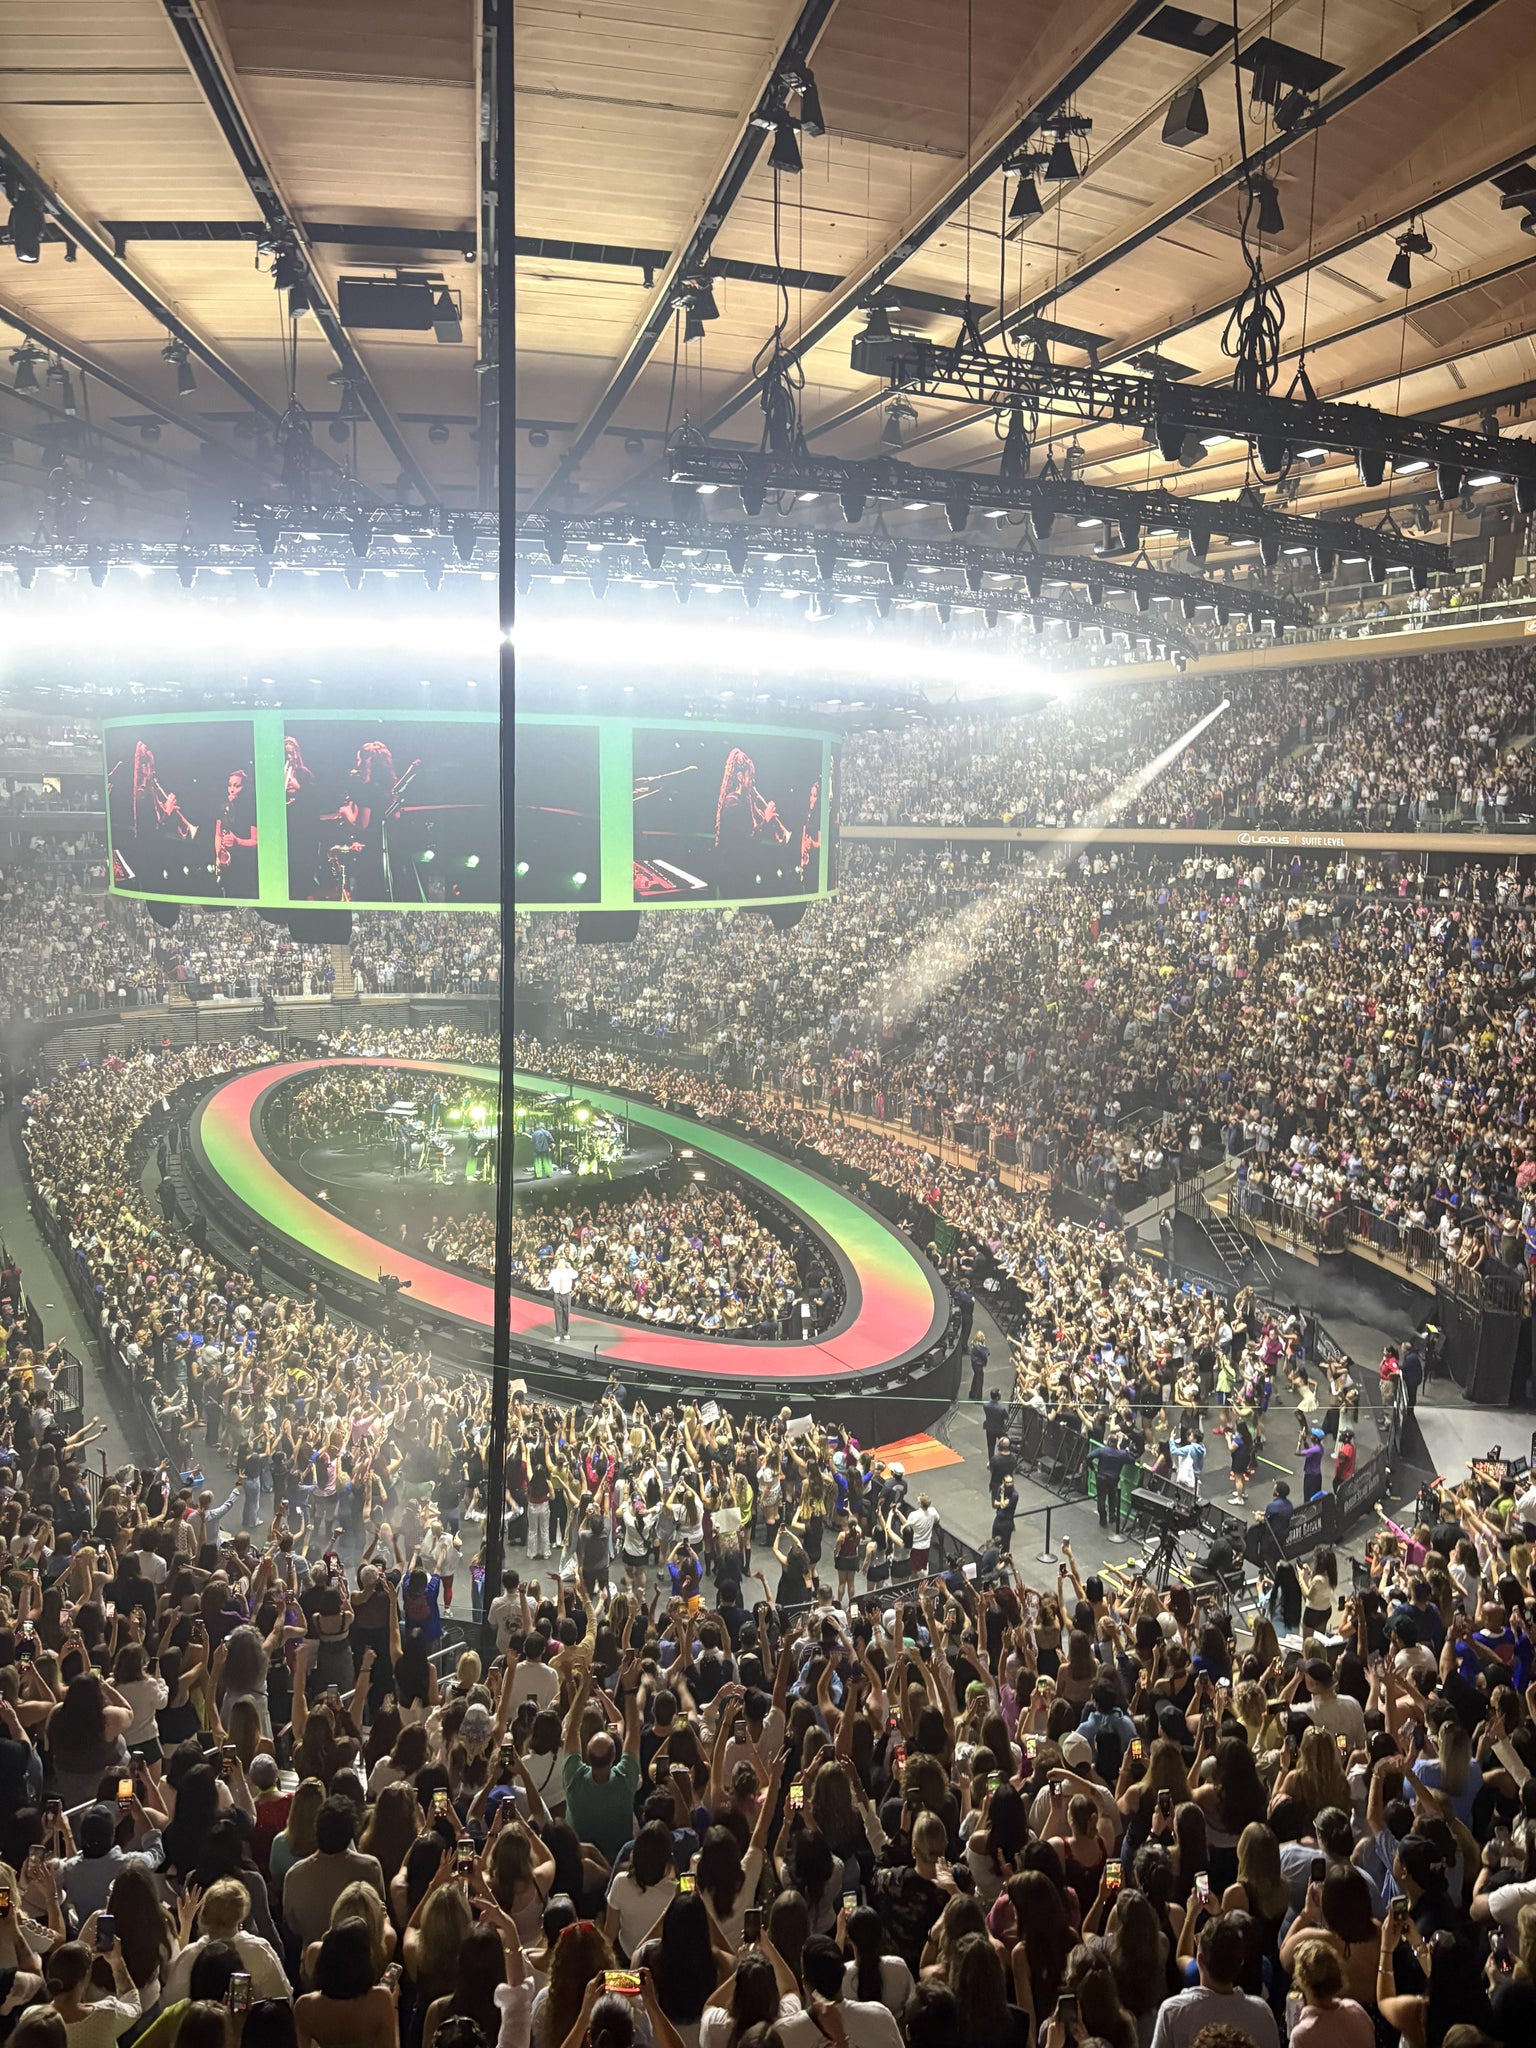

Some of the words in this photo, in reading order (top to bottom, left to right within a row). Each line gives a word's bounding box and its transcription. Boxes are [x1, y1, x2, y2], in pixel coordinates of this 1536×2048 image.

[1252, 836, 1290, 845] LEXUS
[1301, 837, 1322, 846] SUITE
[1323, 837, 1345, 847] LEVEL
